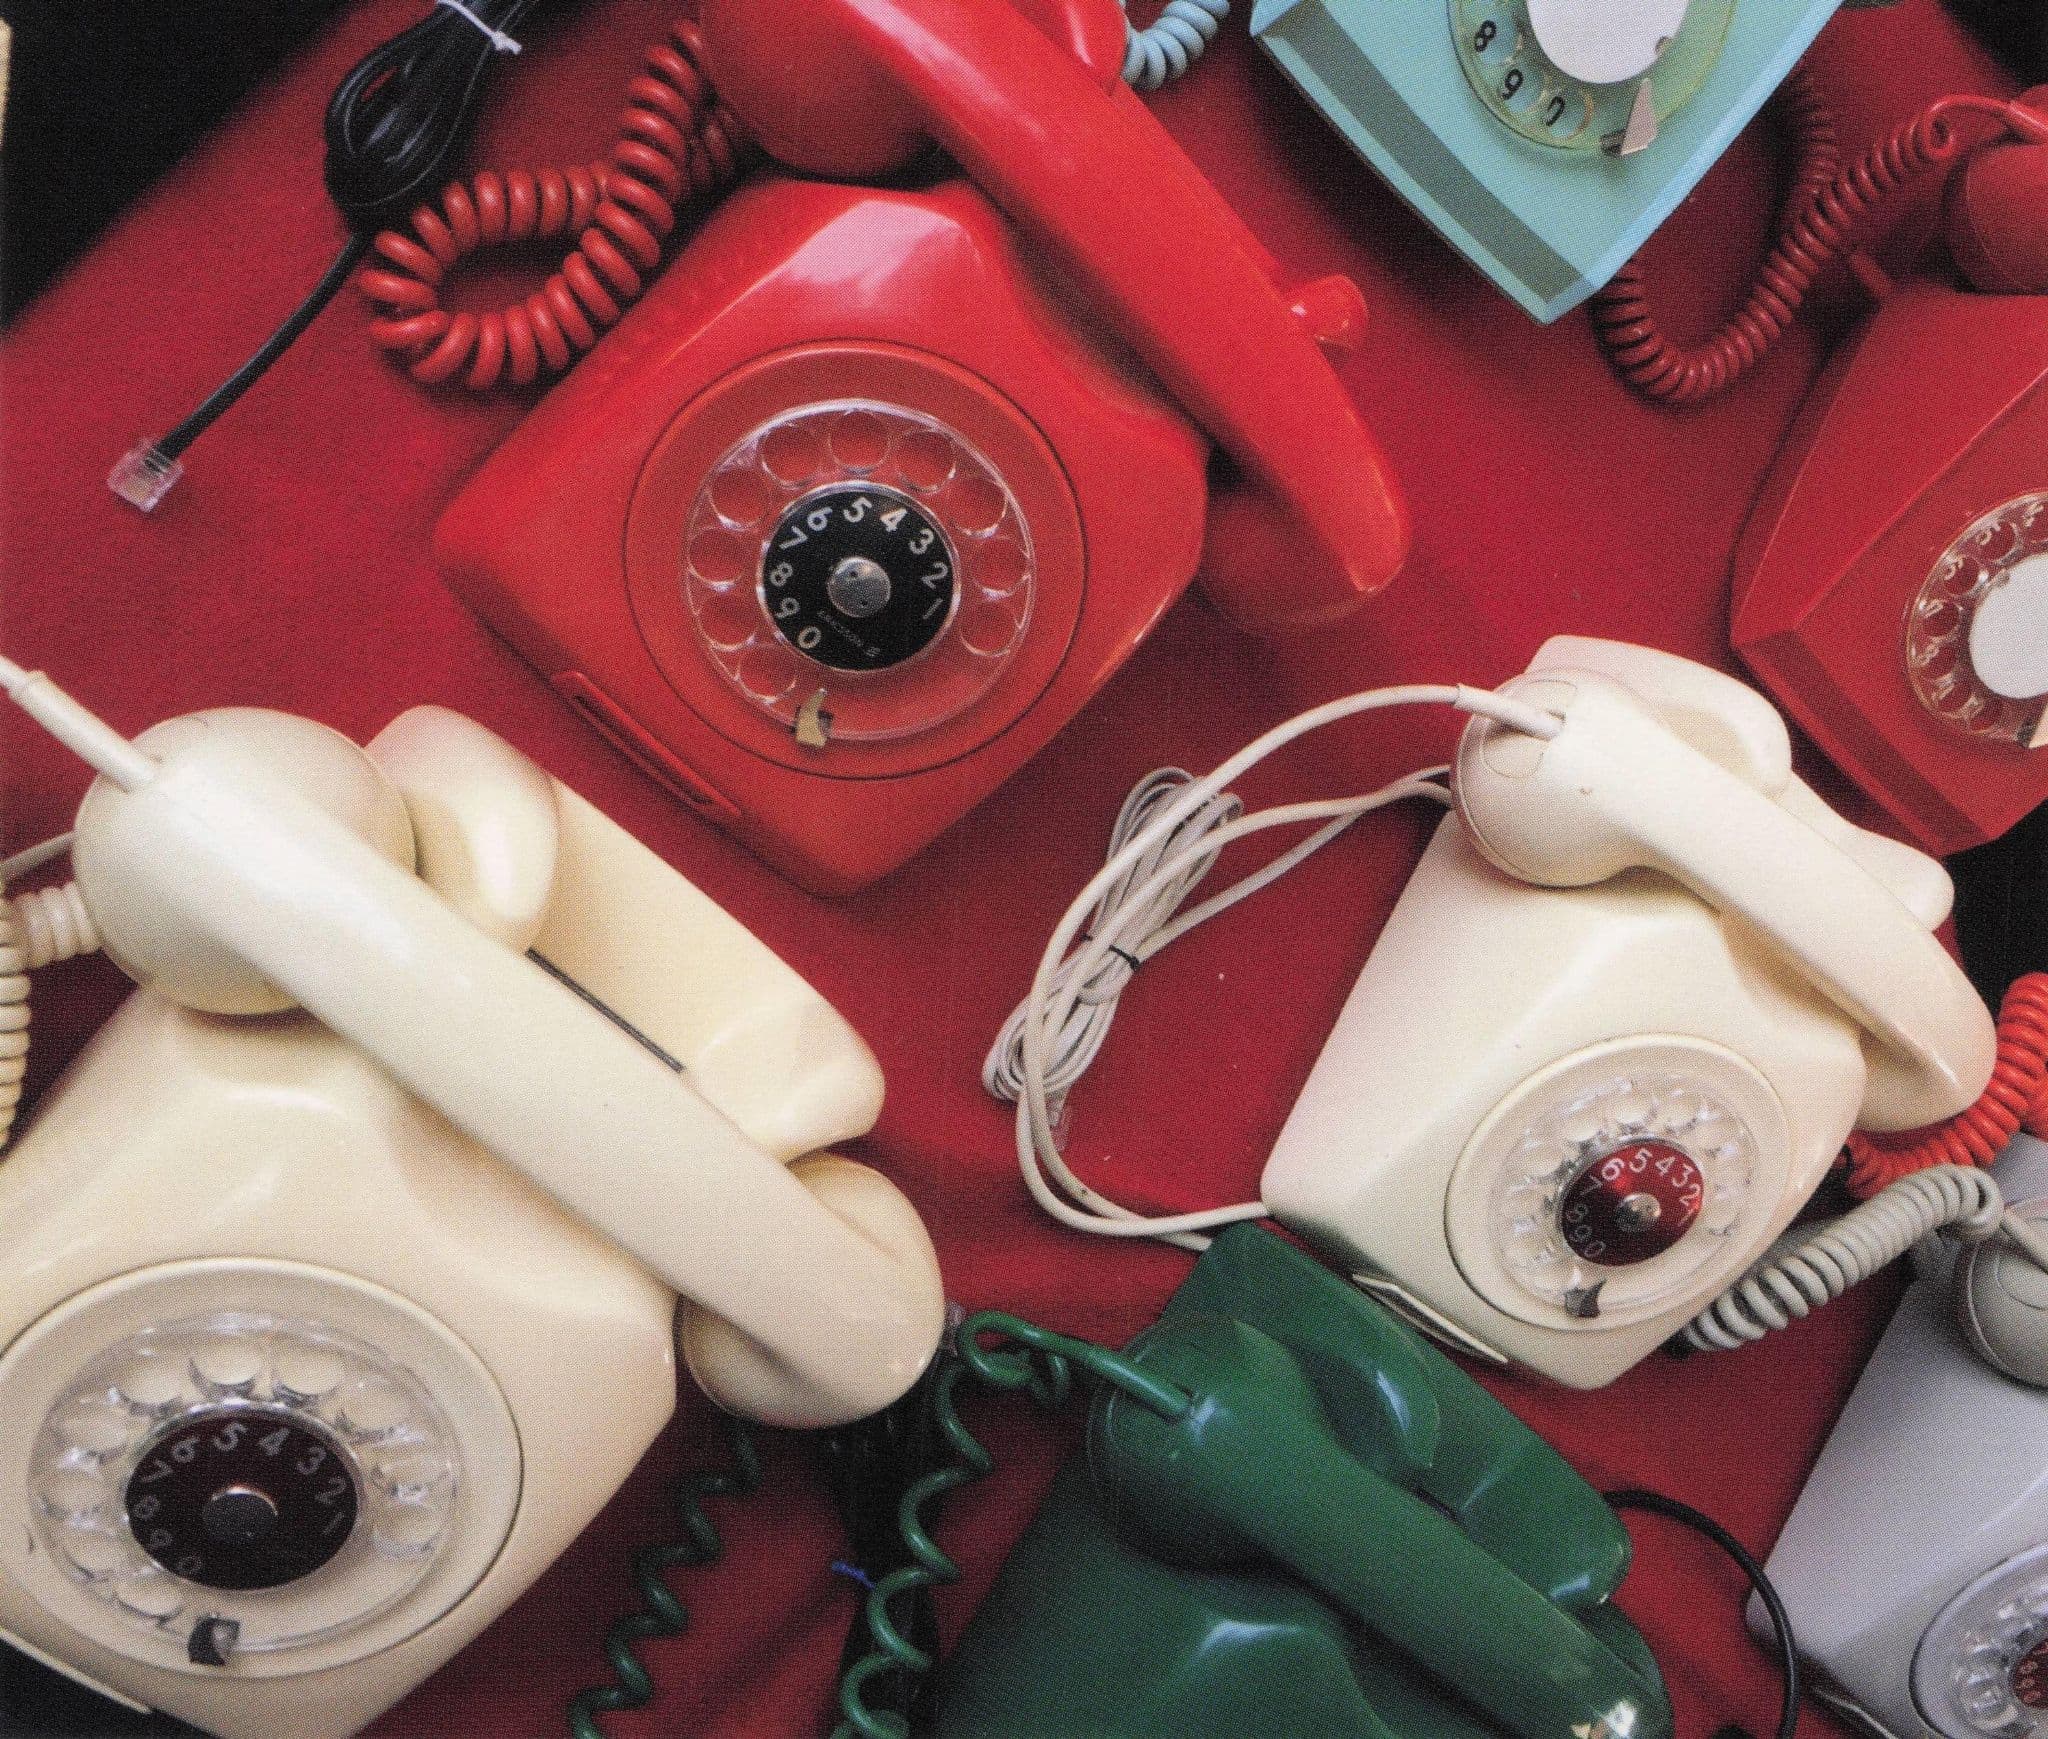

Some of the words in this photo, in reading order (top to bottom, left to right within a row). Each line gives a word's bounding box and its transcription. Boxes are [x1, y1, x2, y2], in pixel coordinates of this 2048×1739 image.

[1474, 20, 1497, 53] 8
[1500, 68, 1524, 101] 9
[806, 506, 833, 532] 6
[843, 496, 873, 523] 5
[880, 506, 908, 533] 4
[778, 526, 808, 551] 7
[909, 528, 935, 555] 3
[770, 562, 793, 588] 8
[921, 561, 949, 590] 2
[776, 597, 800, 619] 9
[922, 598, 943, 620] 1
[798, 625, 823, 649] 0
[1601, 1157, 1626, 1181] 6
[1629, 1148, 1653, 1173] 5
[1655, 1156, 1676, 1177] 4
[1580, 1174, 1604, 1196] 7
[1672, 1163, 1694, 1188] 3
[1679, 1183, 1701, 1207] 2
[1566, 1203, 1589, 1223] 8
[1569, 1224, 1593, 1243] 9
[1584, 1240, 1607, 1258] 0
[212, 1422, 249, 1451] 5
[256, 1427, 290, 1456] 4
[171, 1435, 200, 1464] 6
[296, 1446, 327, 1476] 3
[140, 1458, 174, 1484] 7
[315, 1476, 347, 1505] 2
[133, 1495, 161, 1521] 8
[321, 1511, 346, 1536] 1
[148, 1527, 174, 1551] 9
[176, 1554, 204, 1577] 0
